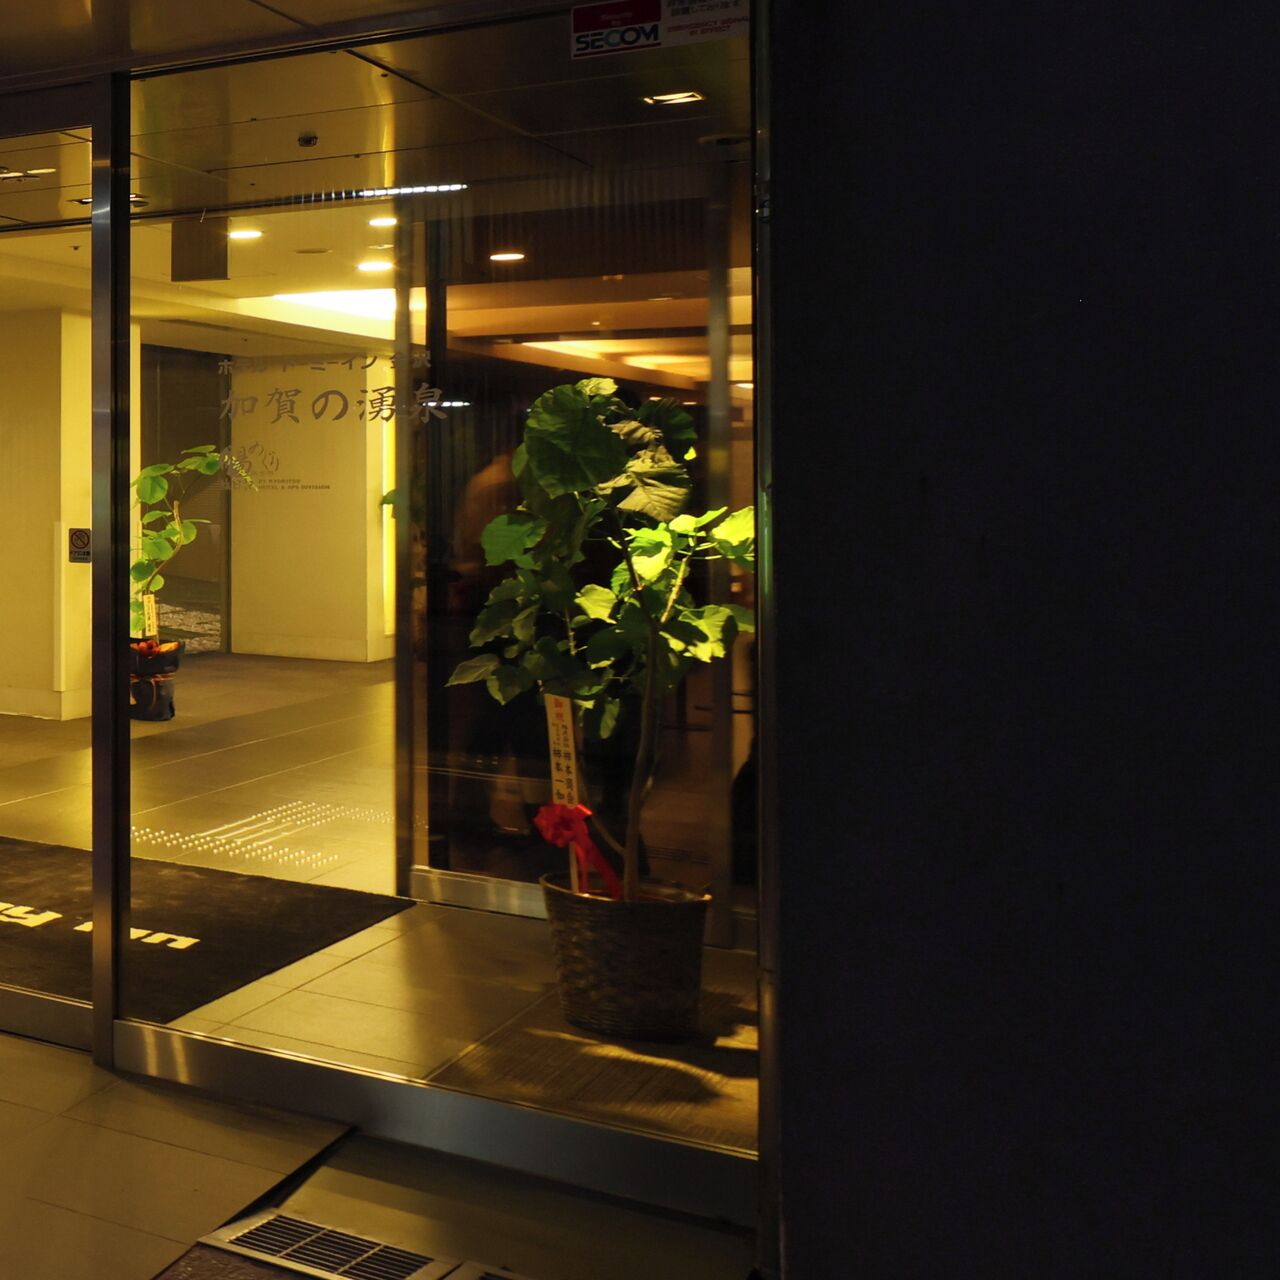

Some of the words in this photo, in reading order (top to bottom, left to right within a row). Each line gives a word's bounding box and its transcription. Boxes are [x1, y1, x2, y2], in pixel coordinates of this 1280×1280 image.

[575, 23, 659, 51] SECOM
[219, 382, 449, 425] 加賀の湧泉
